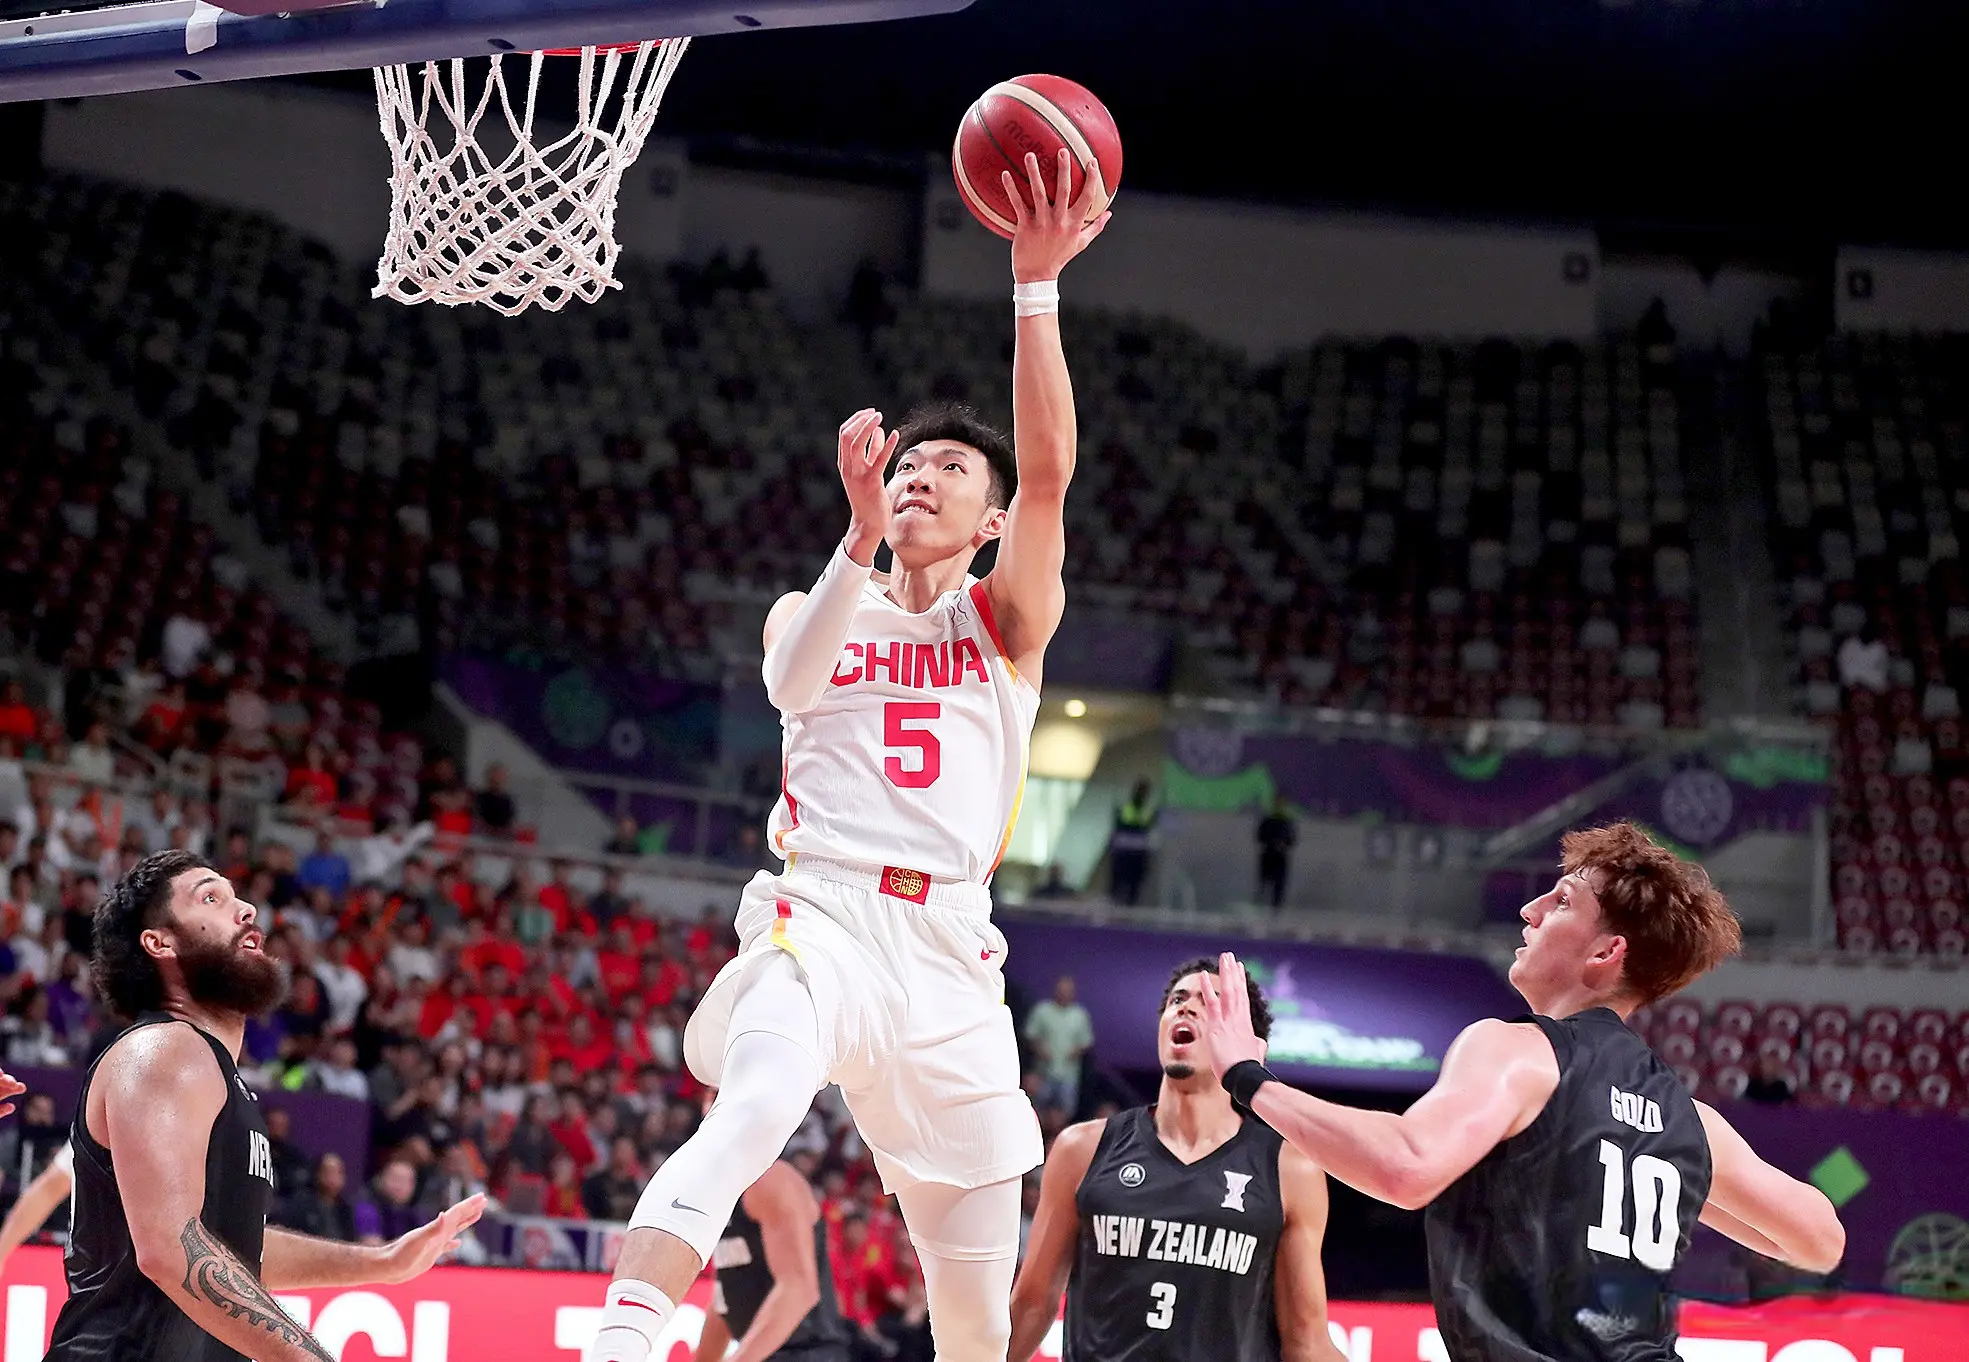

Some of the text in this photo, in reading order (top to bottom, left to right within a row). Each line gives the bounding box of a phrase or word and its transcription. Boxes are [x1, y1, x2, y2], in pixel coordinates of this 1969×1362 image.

[829, 636, 989, 689] CHINA
[883, 701, 941, 789] 5
[1610, 1084, 1665, 1134] GOLD
[1586, 1137, 1683, 1271] 10
[1093, 1214, 1258, 1276] NEW ZEALAND
[1146, 1281, 1177, 1331] 3
